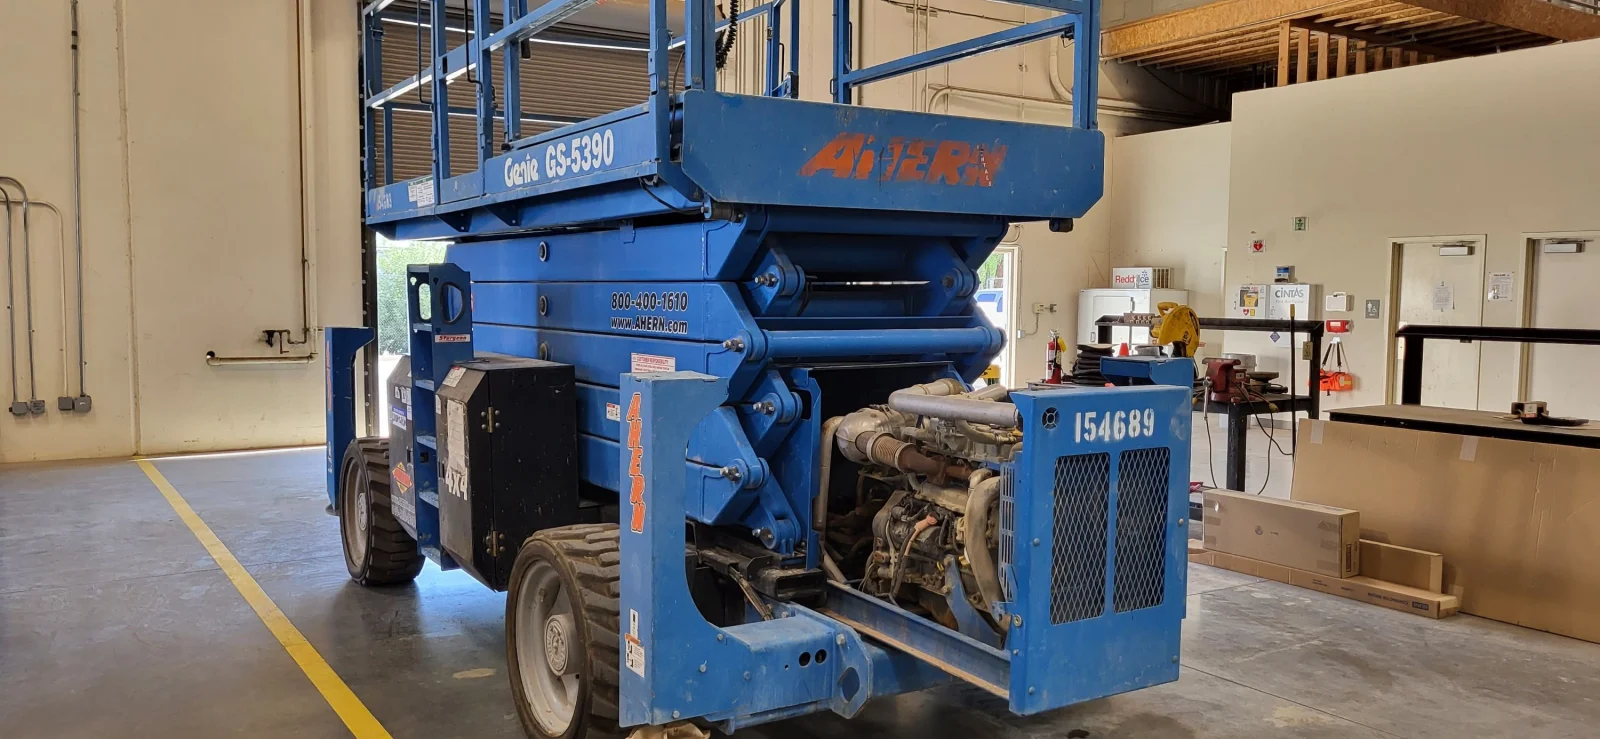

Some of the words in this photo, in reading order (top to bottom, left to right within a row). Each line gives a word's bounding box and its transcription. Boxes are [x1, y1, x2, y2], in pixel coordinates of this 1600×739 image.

[505, 153, 538, 187] Genie
[546, 129, 614, 178] GS-5390
[611, 292, 688, 311] 800-400-1610
[611, 315, 688, 334] www.AHERN.com
[1075, 408, 1155, 443] 154689
[626, 392, 646, 534] AHERN
